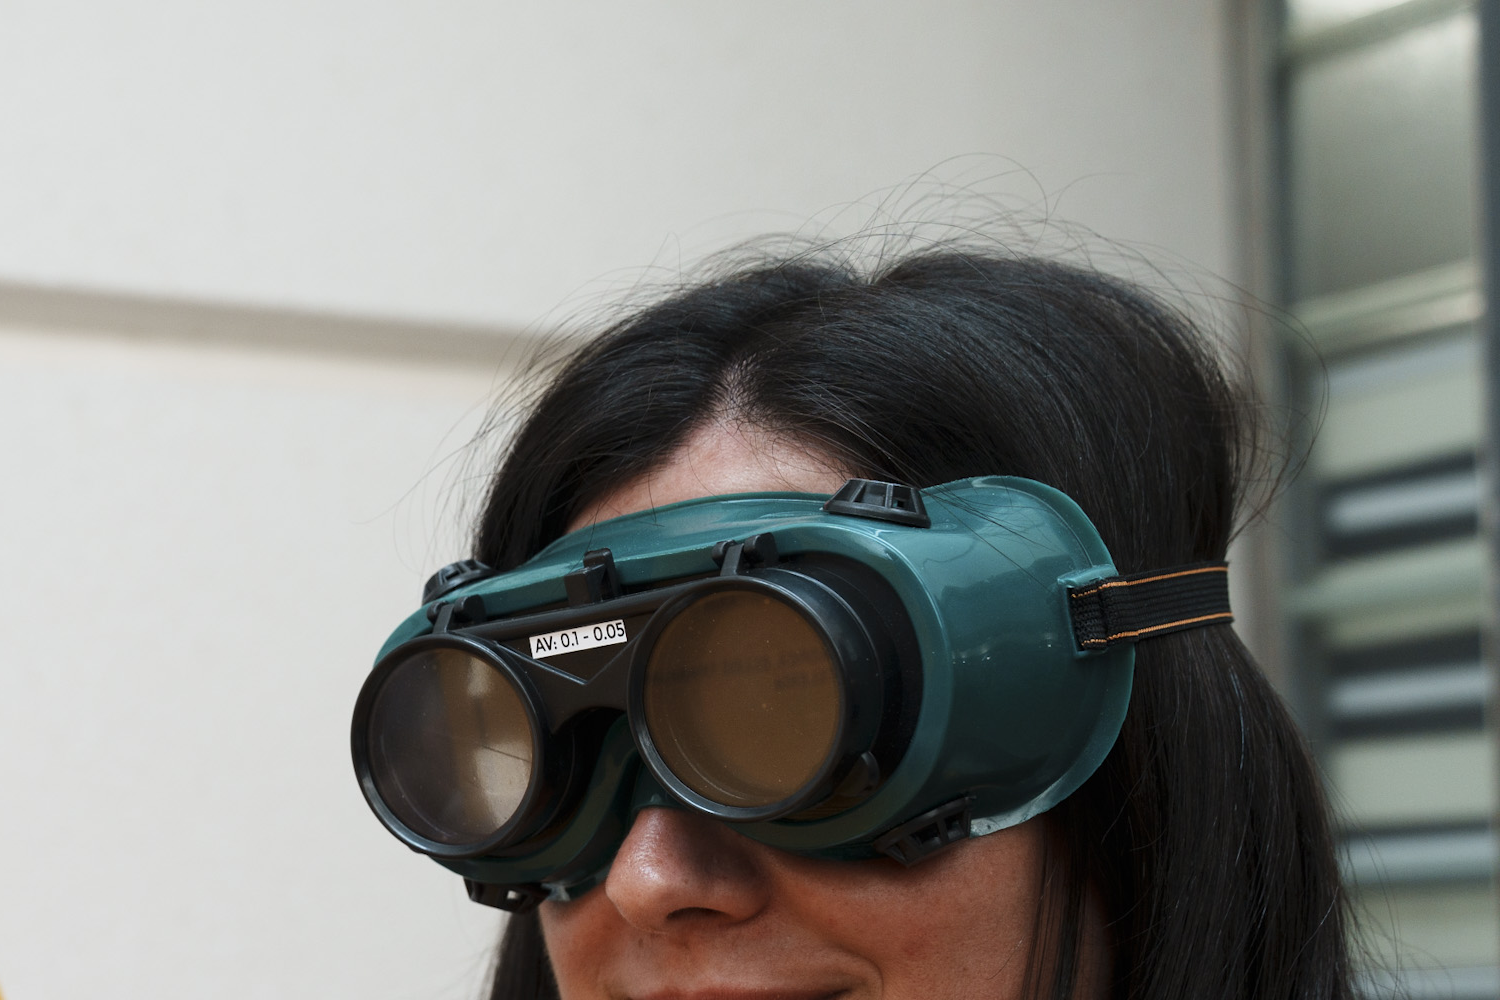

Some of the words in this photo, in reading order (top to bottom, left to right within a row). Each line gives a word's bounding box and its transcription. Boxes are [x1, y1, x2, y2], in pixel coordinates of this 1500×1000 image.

[535, 636, 558, 654] AV:
[561, 631, 580, 648] 0.1
[593, 622, 625, 642] 0.05
